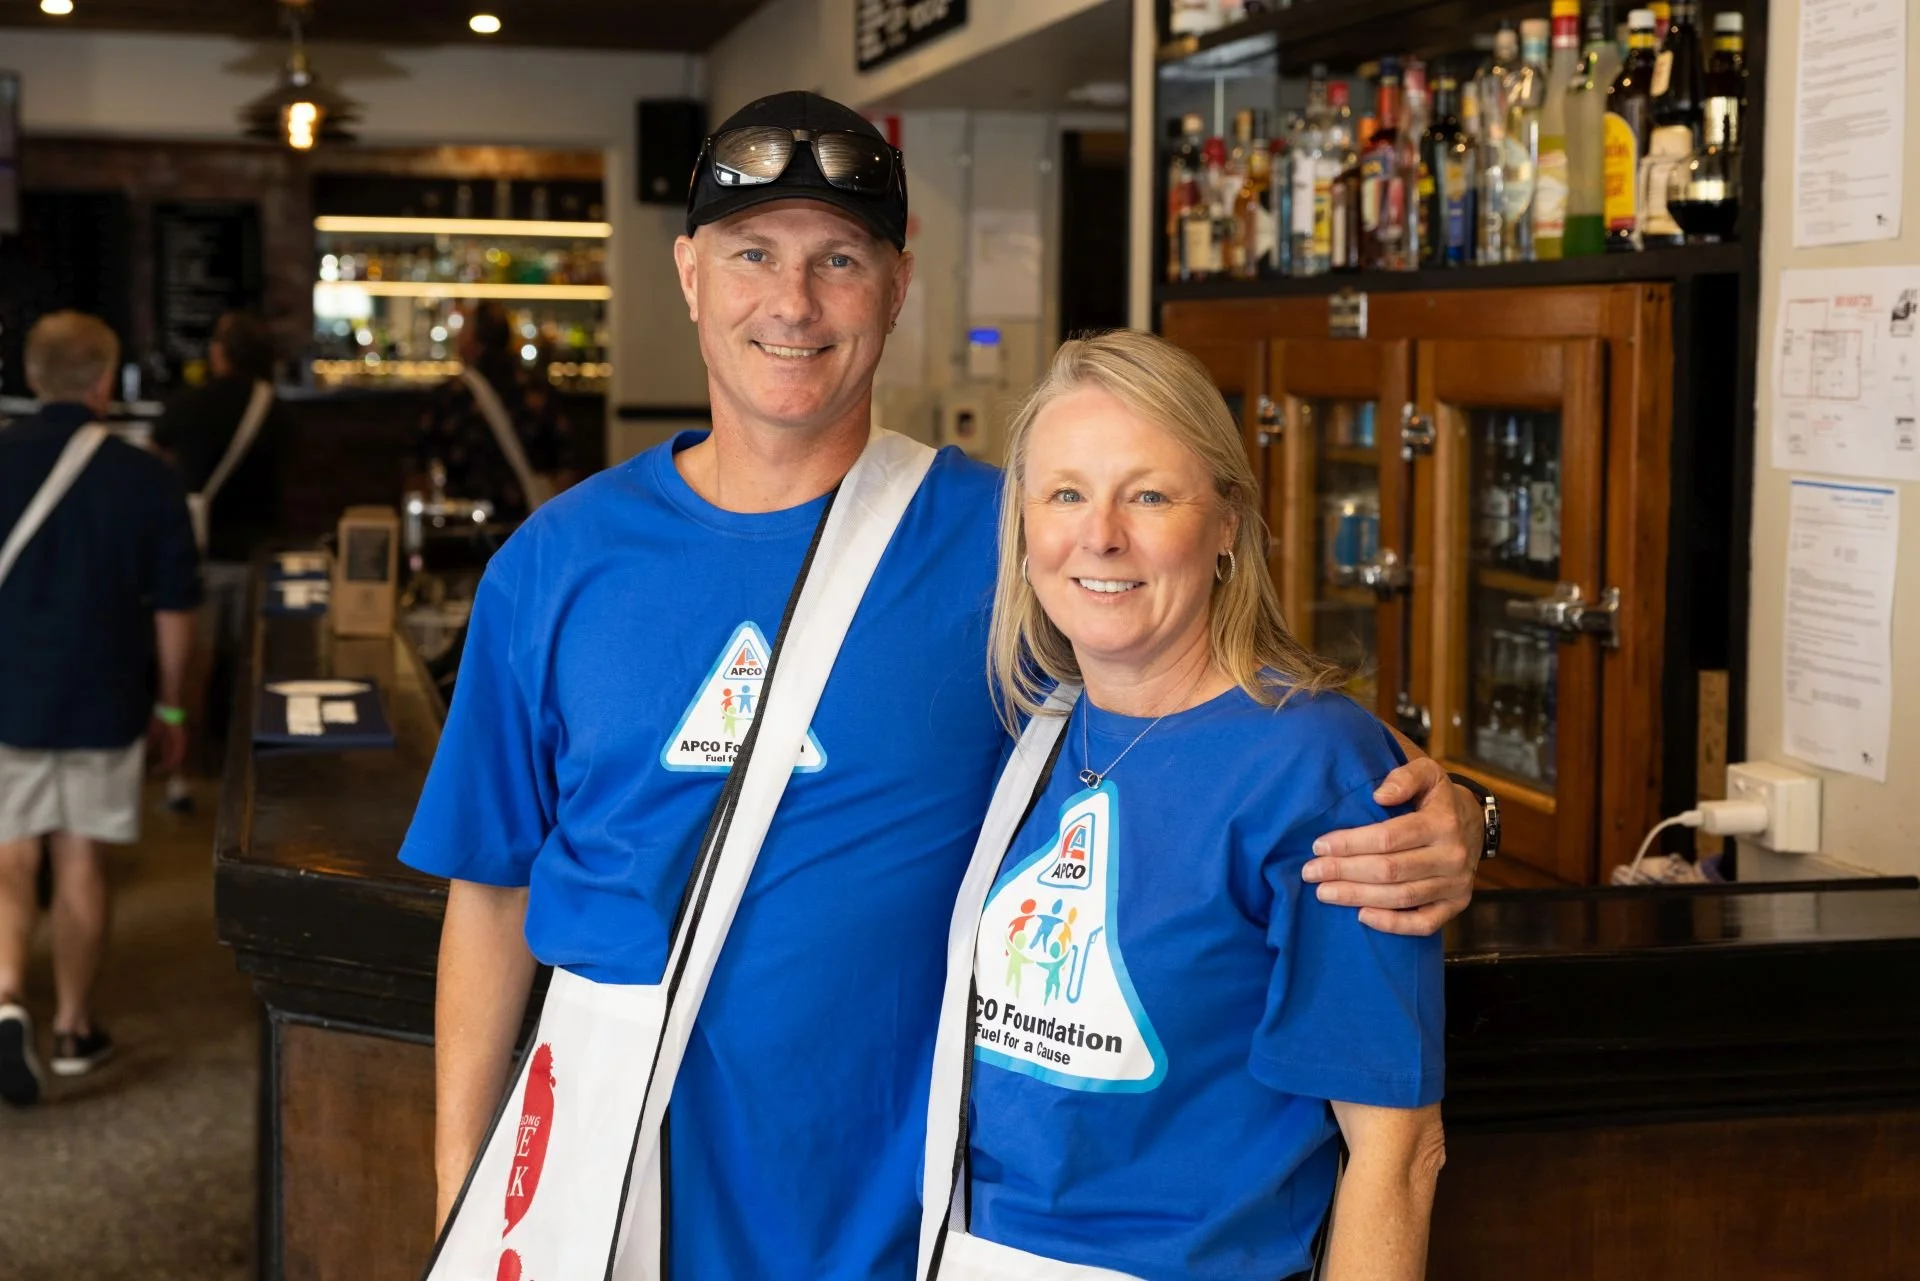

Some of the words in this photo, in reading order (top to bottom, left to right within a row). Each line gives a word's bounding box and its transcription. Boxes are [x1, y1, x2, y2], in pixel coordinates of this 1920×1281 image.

[731, 667, 762, 676] APCO
[680, 740, 721, 752] APCO
[705, 754, 726, 762] Fuel
[1051, 863, 1086, 879] APCO
[976, 995, 998, 1020] CO
[1002, 1003, 1122, 1053] Foundation
[975, 1022, 1001, 1043] Fuel
[1003, 1032, 1019, 1049] for
[1023, 1041, 1033, 1053] a
[1036, 1041, 1071, 1065] Cause
